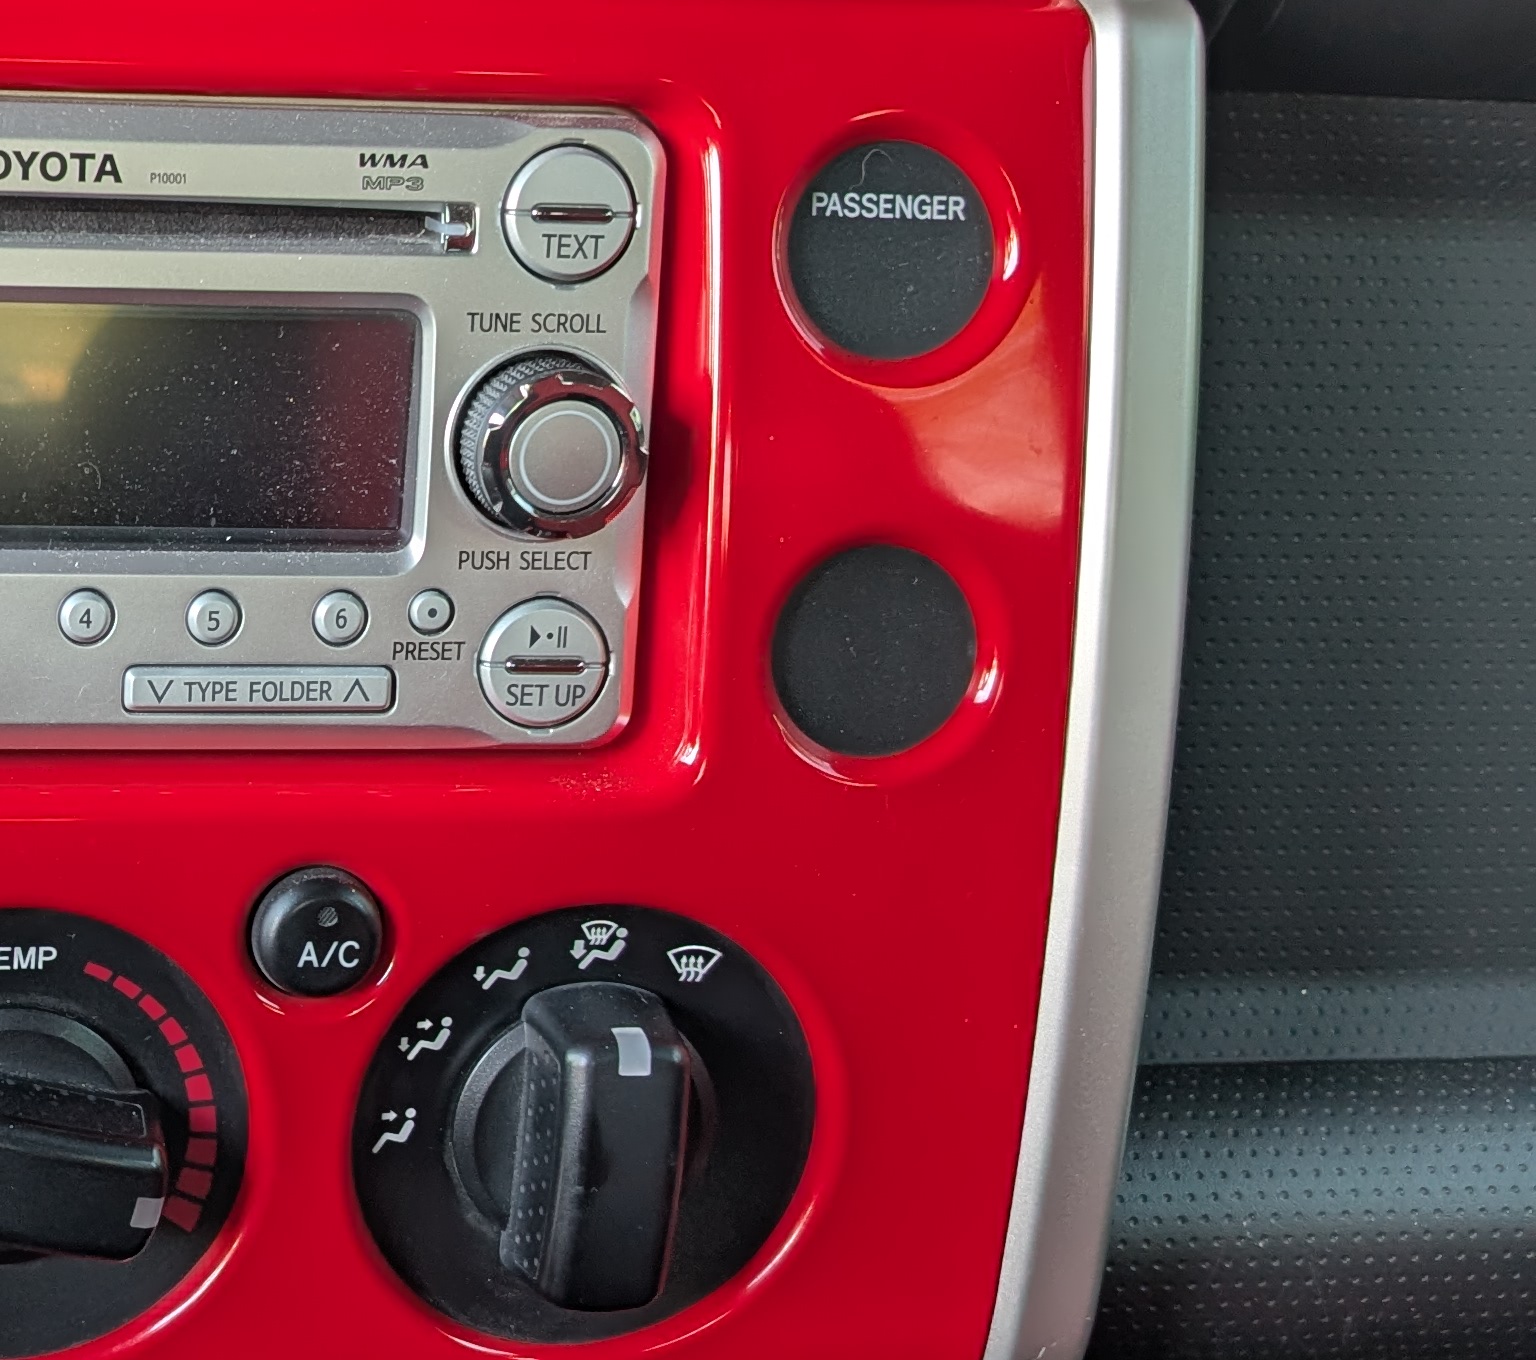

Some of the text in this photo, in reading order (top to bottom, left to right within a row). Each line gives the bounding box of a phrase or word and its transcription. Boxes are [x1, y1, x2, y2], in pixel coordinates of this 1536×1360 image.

[359, 153, 429, 169] WMA
[150, 172, 187, 184] P10001
[362, 176, 425, 191] MP3
[811, 192, 966, 221] PASSENGER
[542, 233, 605, 260] TEXT
[467, 312, 606, 333] TUNE SCROLL
[458, 550, 592, 571] PUSH SELECT
[78, 607, 93, 629] 4
[208, 609, 220, 631] 5
[335, 607, 348, 630] 6
[392, 641, 466, 661] PRESET
[184, 680, 333, 703] TYPE FOLDER
[505, 684, 586, 707] SET UP
[297, 940, 360, 968] A/C
